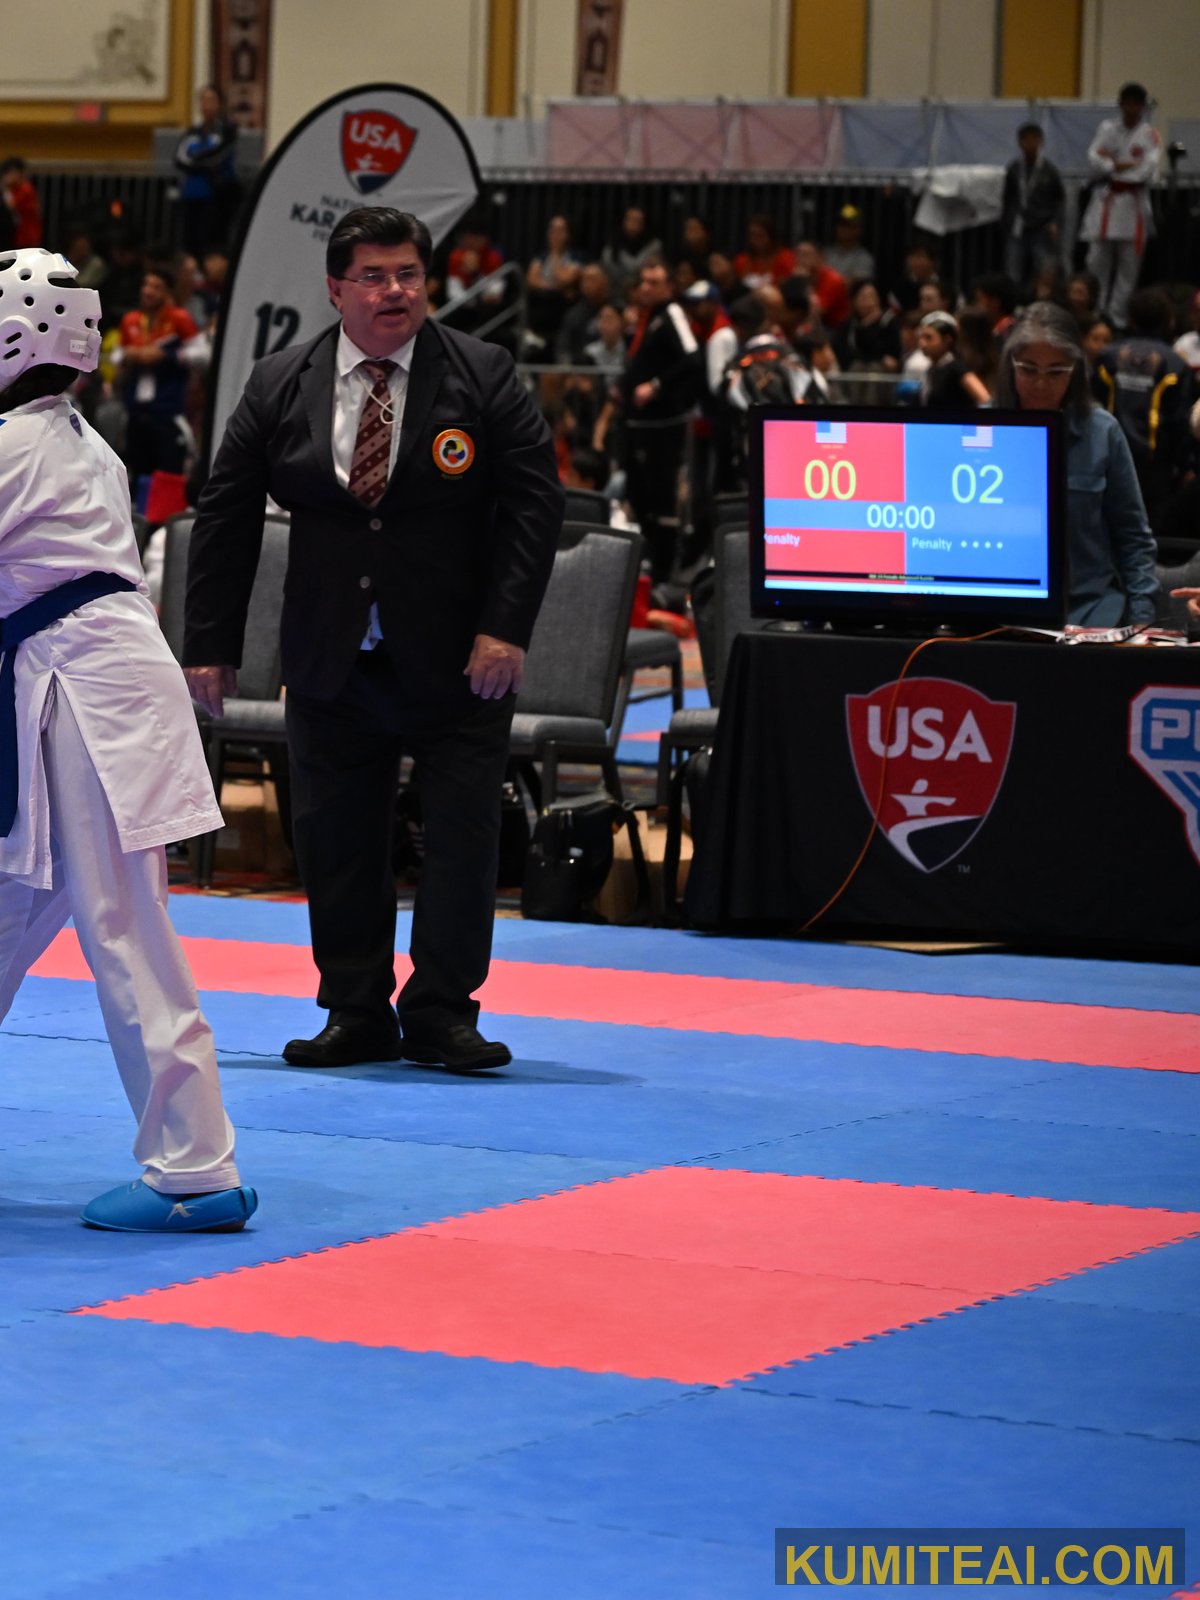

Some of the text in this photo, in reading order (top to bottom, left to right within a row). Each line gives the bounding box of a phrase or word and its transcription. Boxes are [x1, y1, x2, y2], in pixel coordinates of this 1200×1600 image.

[349, 119, 402, 152] USA
[254, 302, 301, 361] 12
[804, 459, 857, 500] 00
[952, 464, 1004, 504] 02
[866, 504, 936, 530] 00:00
[911, 537, 952, 552] Penalty
[867, 705, 993, 763] USA
